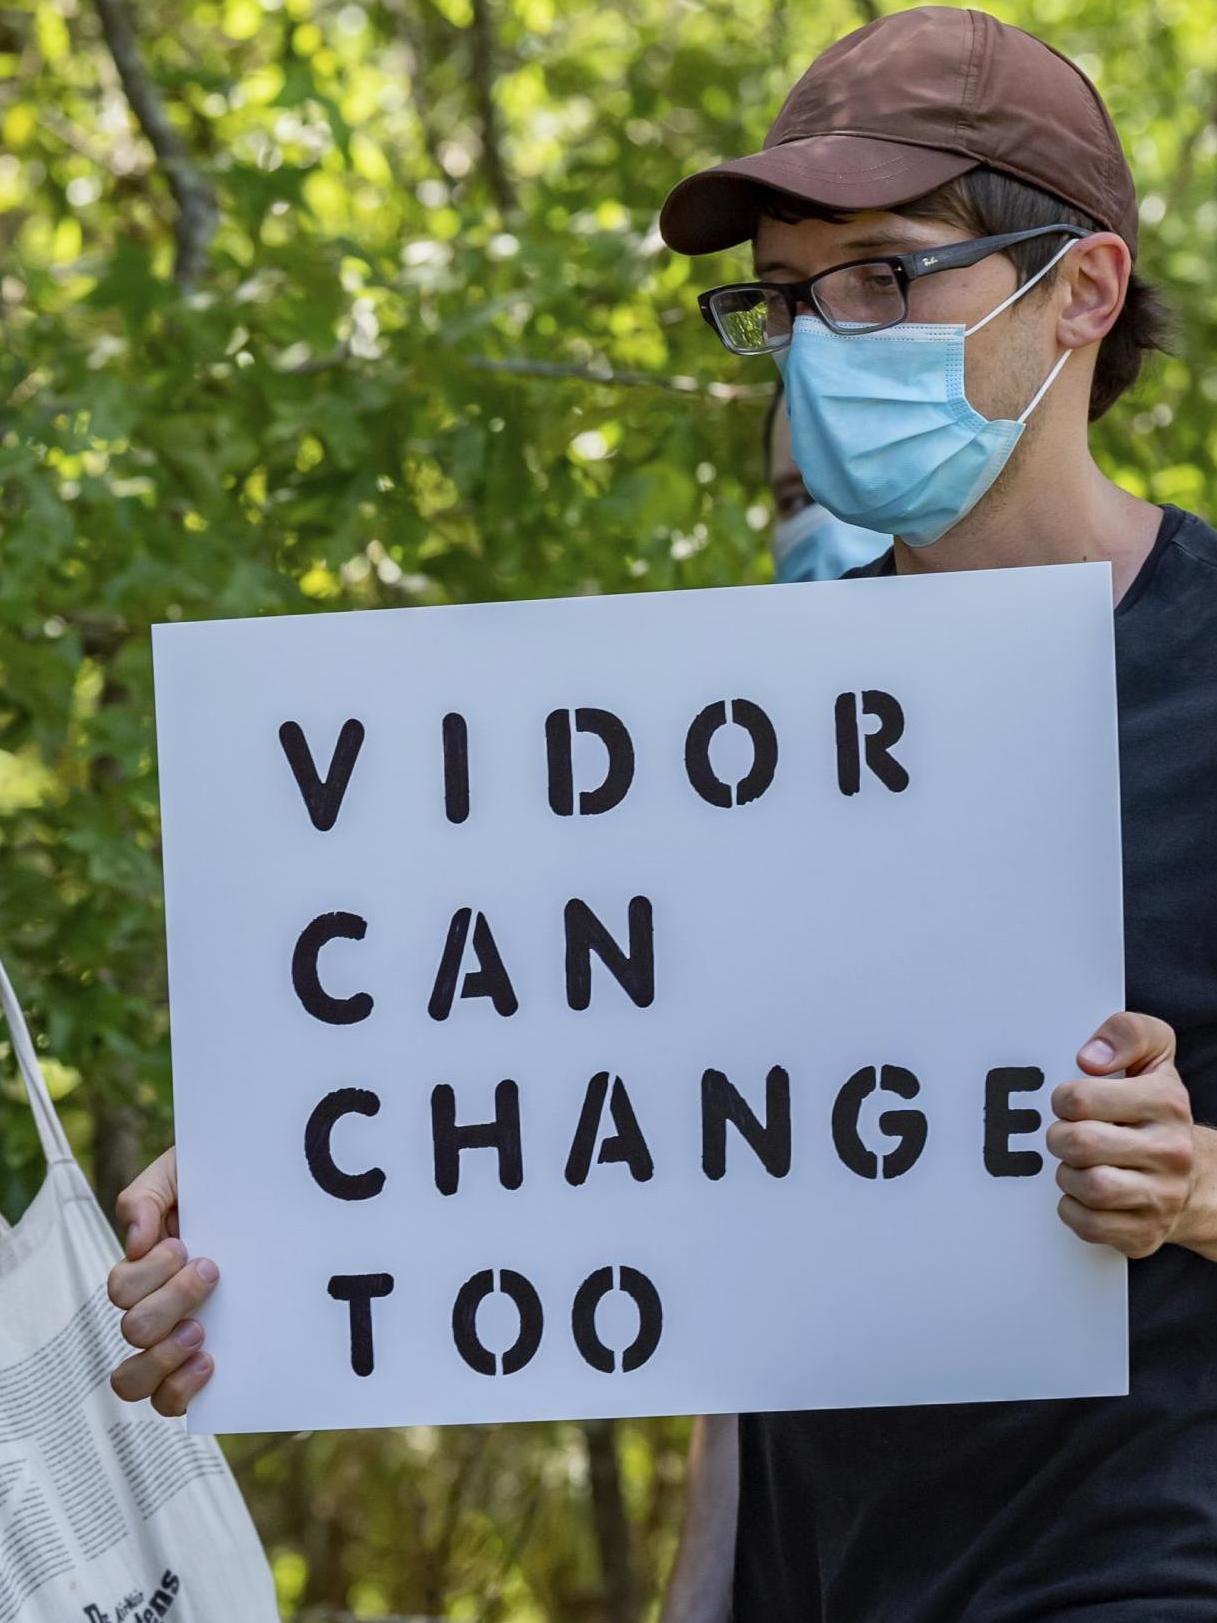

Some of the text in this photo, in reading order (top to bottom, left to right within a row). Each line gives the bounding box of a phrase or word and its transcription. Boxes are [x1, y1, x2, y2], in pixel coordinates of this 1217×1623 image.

[278, 690, 910, 831] VIDOR
[291, 896, 655, 1025] CAN
[304, 1064, 1045, 1201] CHANGE
[327, 1265, 663, 1377] TOO
